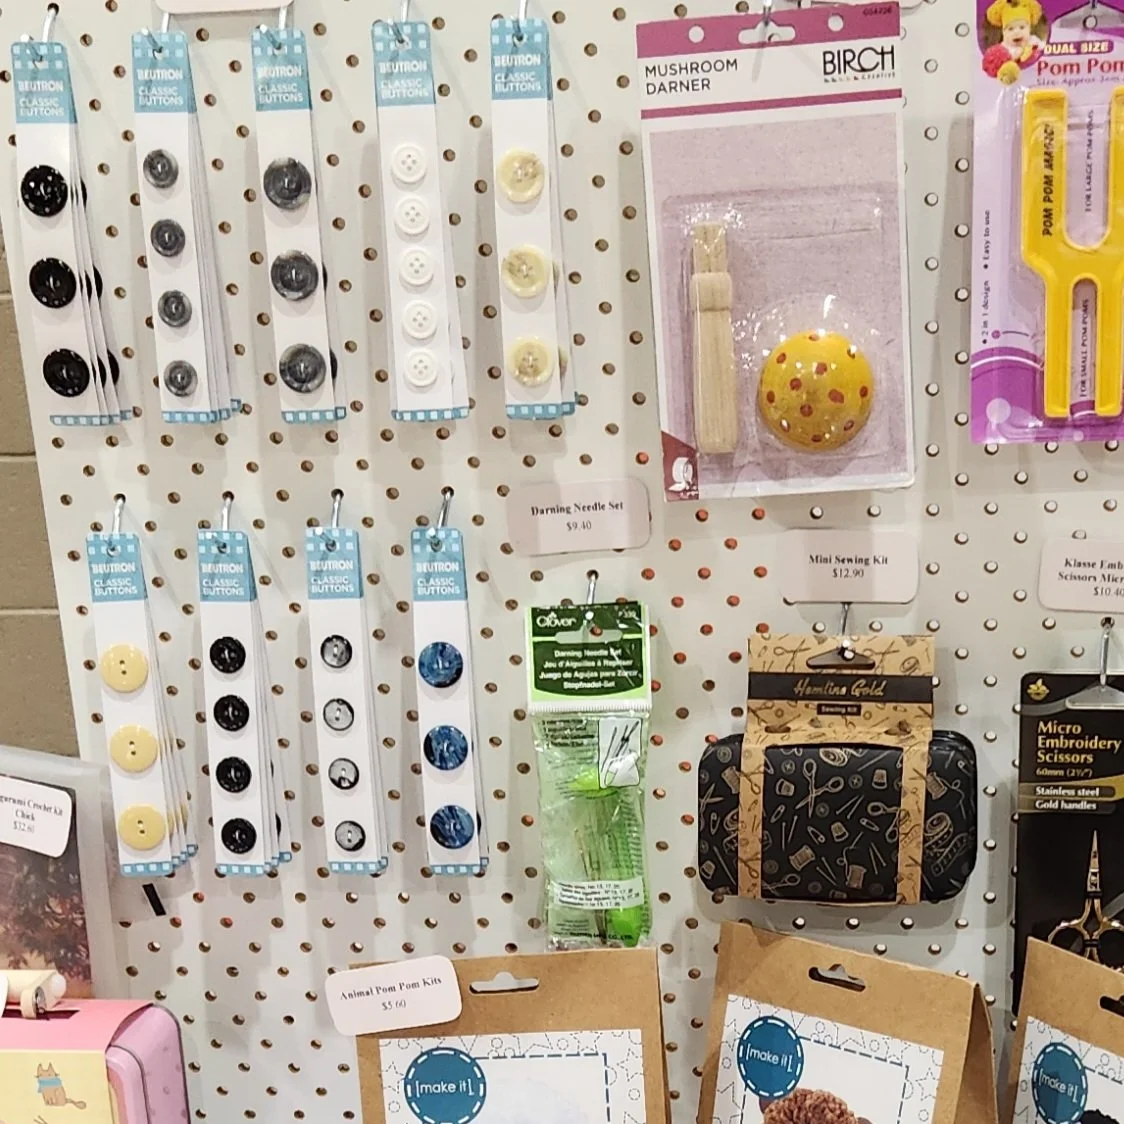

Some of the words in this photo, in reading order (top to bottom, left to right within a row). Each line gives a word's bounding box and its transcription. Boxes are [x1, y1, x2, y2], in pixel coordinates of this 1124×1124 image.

[1044, 42, 1077, 54] DUAL
[1081, 41, 1109, 53] SIZE
[494, 54, 541, 67] BEUTRON
[822, 45, 896, 76] BIRCH
[137, 68, 183, 80] BEUTRON
[257, 65, 302, 78] BEUTRON
[645, 58, 738, 78] MUSHROOM
[1037, 60, 1081, 76] Pom
[495, 72, 536, 82] CLASSIC
[18, 80, 63, 92] BEUTRON
[495, 81, 541, 92] BUTTONS
[646, 78, 711, 95] DARNER
[258, 91, 304, 103] BUTTONS
[531, 504, 572, 516] Darning
[574, 502, 606, 513] Needle
[609, 500, 624, 510] Set
[566, 521, 592, 531] $9.40
[809, 555, 832, 564] Mini
[835, 555, 870, 566] Sewing
[873, 555, 888, 564] Kit
[1064, 558, 1097, 569] Klasse
[416, 561, 459, 573] BEUTRON
[832, 568, 864, 579] $12.90
[93, 577, 132, 588] CLASSIC
[311, 576, 350, 586] CLASSIC
[417, 577, 454, 587] CLASSIC
[94, 586, 138, 597] BUTTONS
[202, 587, 245, 597] BUTTONS
[311, 584, 355, 594] BUTTONS
[536, 612, 577, 628] Clover
[1037, 720, 1081, 734] Micro
[1037, 735, 1122, 754] Embroidery
[1037, 750, 1094, 763] Scissors
[1035, 786, 1076, 796] Stainless
[1078, 786, 1100, 797] steel
[1035, 800, 1059, 810] Gold
[1061, 800, 1097, 810] handles
[15, 809, 35, 821] Chick
[339, 983, 374, 1000] Animal
[375, 981, 397, 996] Pom
[399, 978, 420, 994] Pom
[422, 975, 442, 989] Kits
[415, 1080, 457, 1098] [make
[459, 1077, 476, 1096] it]
